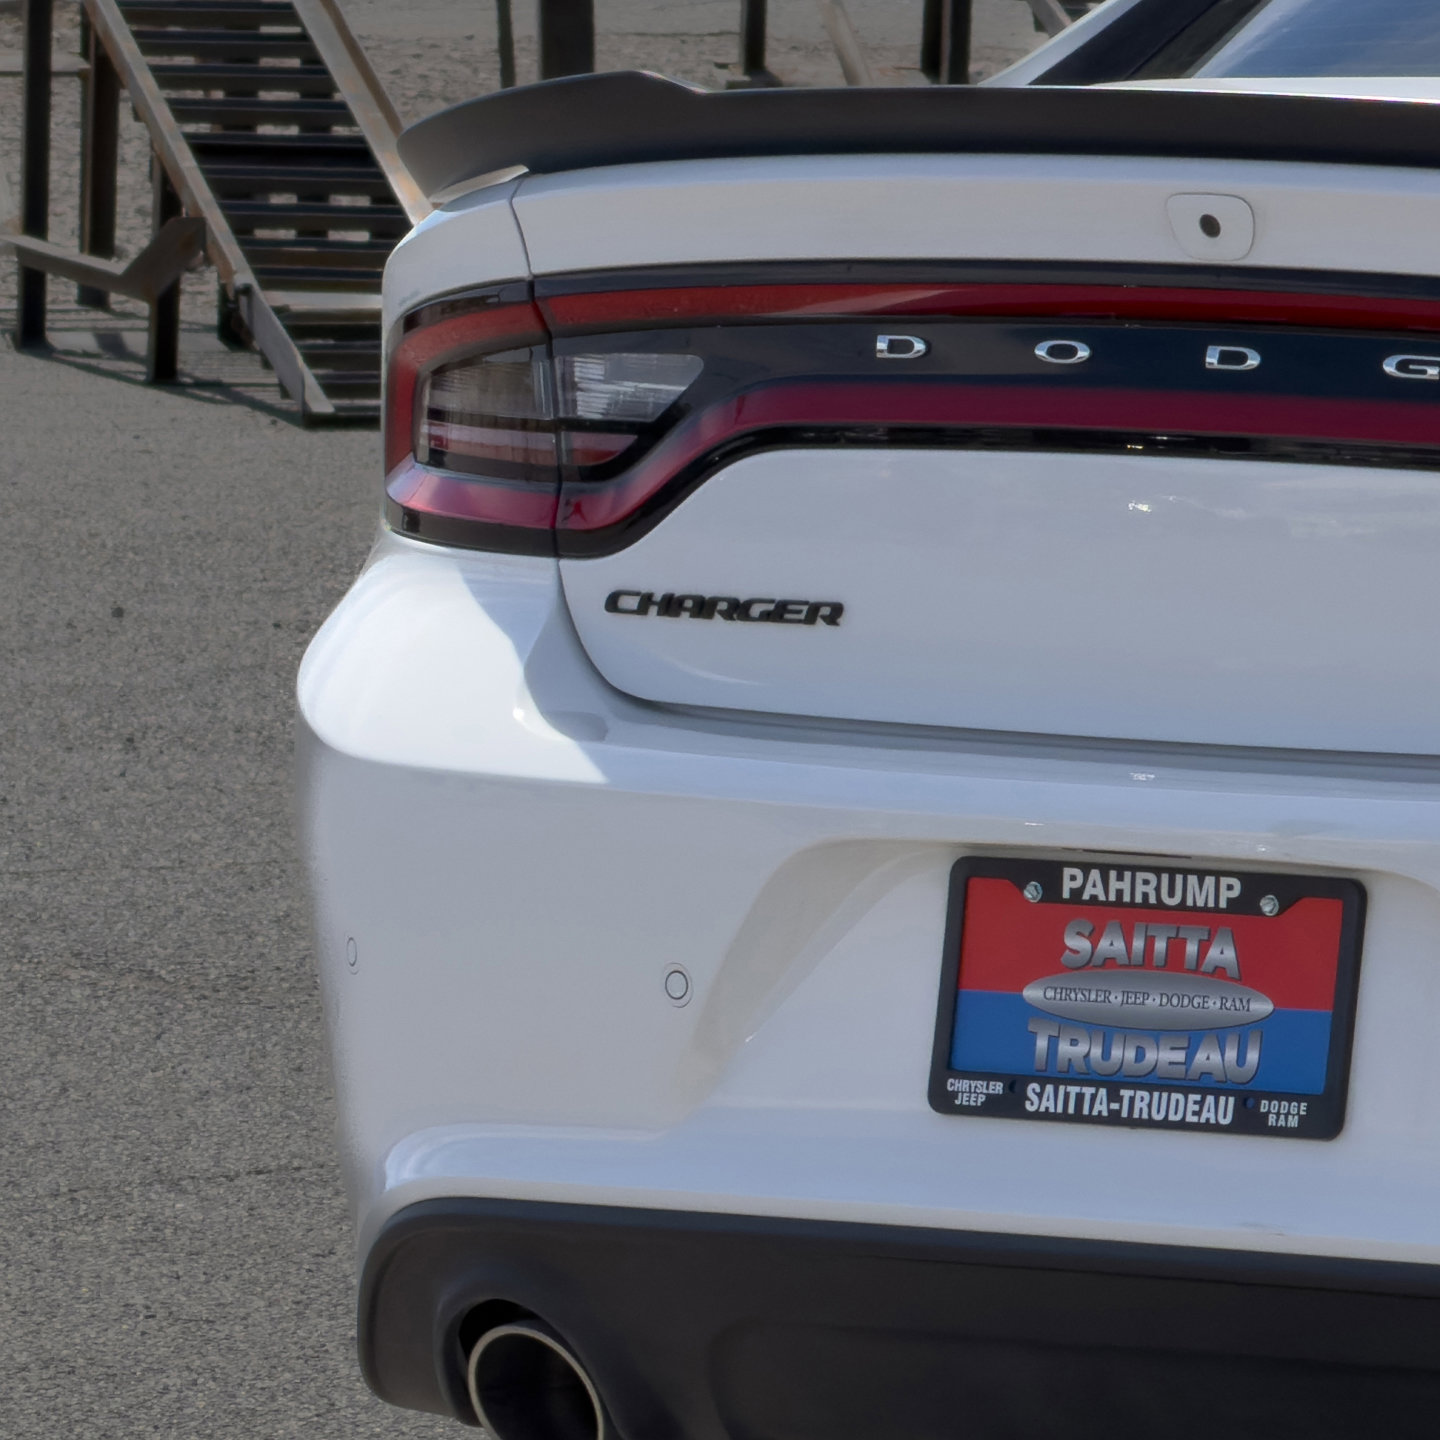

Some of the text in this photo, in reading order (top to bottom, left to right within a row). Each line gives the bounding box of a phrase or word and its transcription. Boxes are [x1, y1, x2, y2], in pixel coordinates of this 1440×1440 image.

[603, 587, 845, 628] CHARGER
[1062, 866, 1242, 910] PAHRUMP
[1059, 918, 1242, 981] SAITTA
[1042, 985, 1252, 1014] CHRYSLER JEEP DODGE RAM
[1027, 1017, 1264, 1087] TRUDEAU
[946, 1077, 1004, 1096] CHRYSLER
[953, 1090, 987, 1108] JEEP
[1024, 1082, 1237, 1126] SAITTA-TRUDEAU
[1259, 1099, 1308, 1116] DODGE
[1267, 1112, 1300, 1129] RAM
